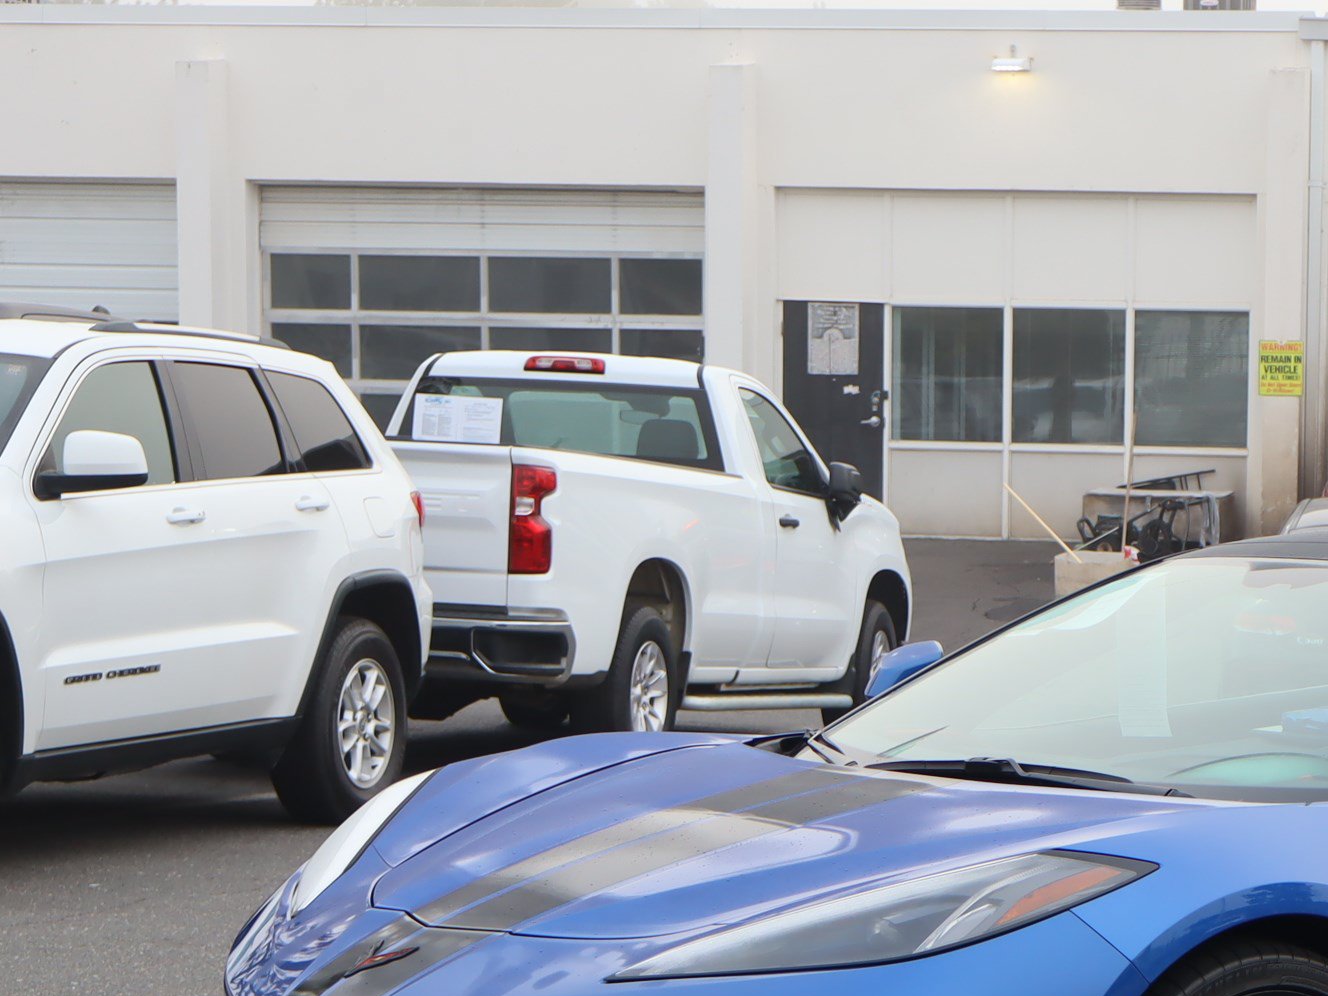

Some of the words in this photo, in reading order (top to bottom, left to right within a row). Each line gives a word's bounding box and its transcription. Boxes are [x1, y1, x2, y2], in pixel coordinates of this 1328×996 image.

[1261, 355, 1292, 363] REMAIN
[1294, 355, 1302, 363] IN
[1264, 365, 1298, 374] VEHICLE
